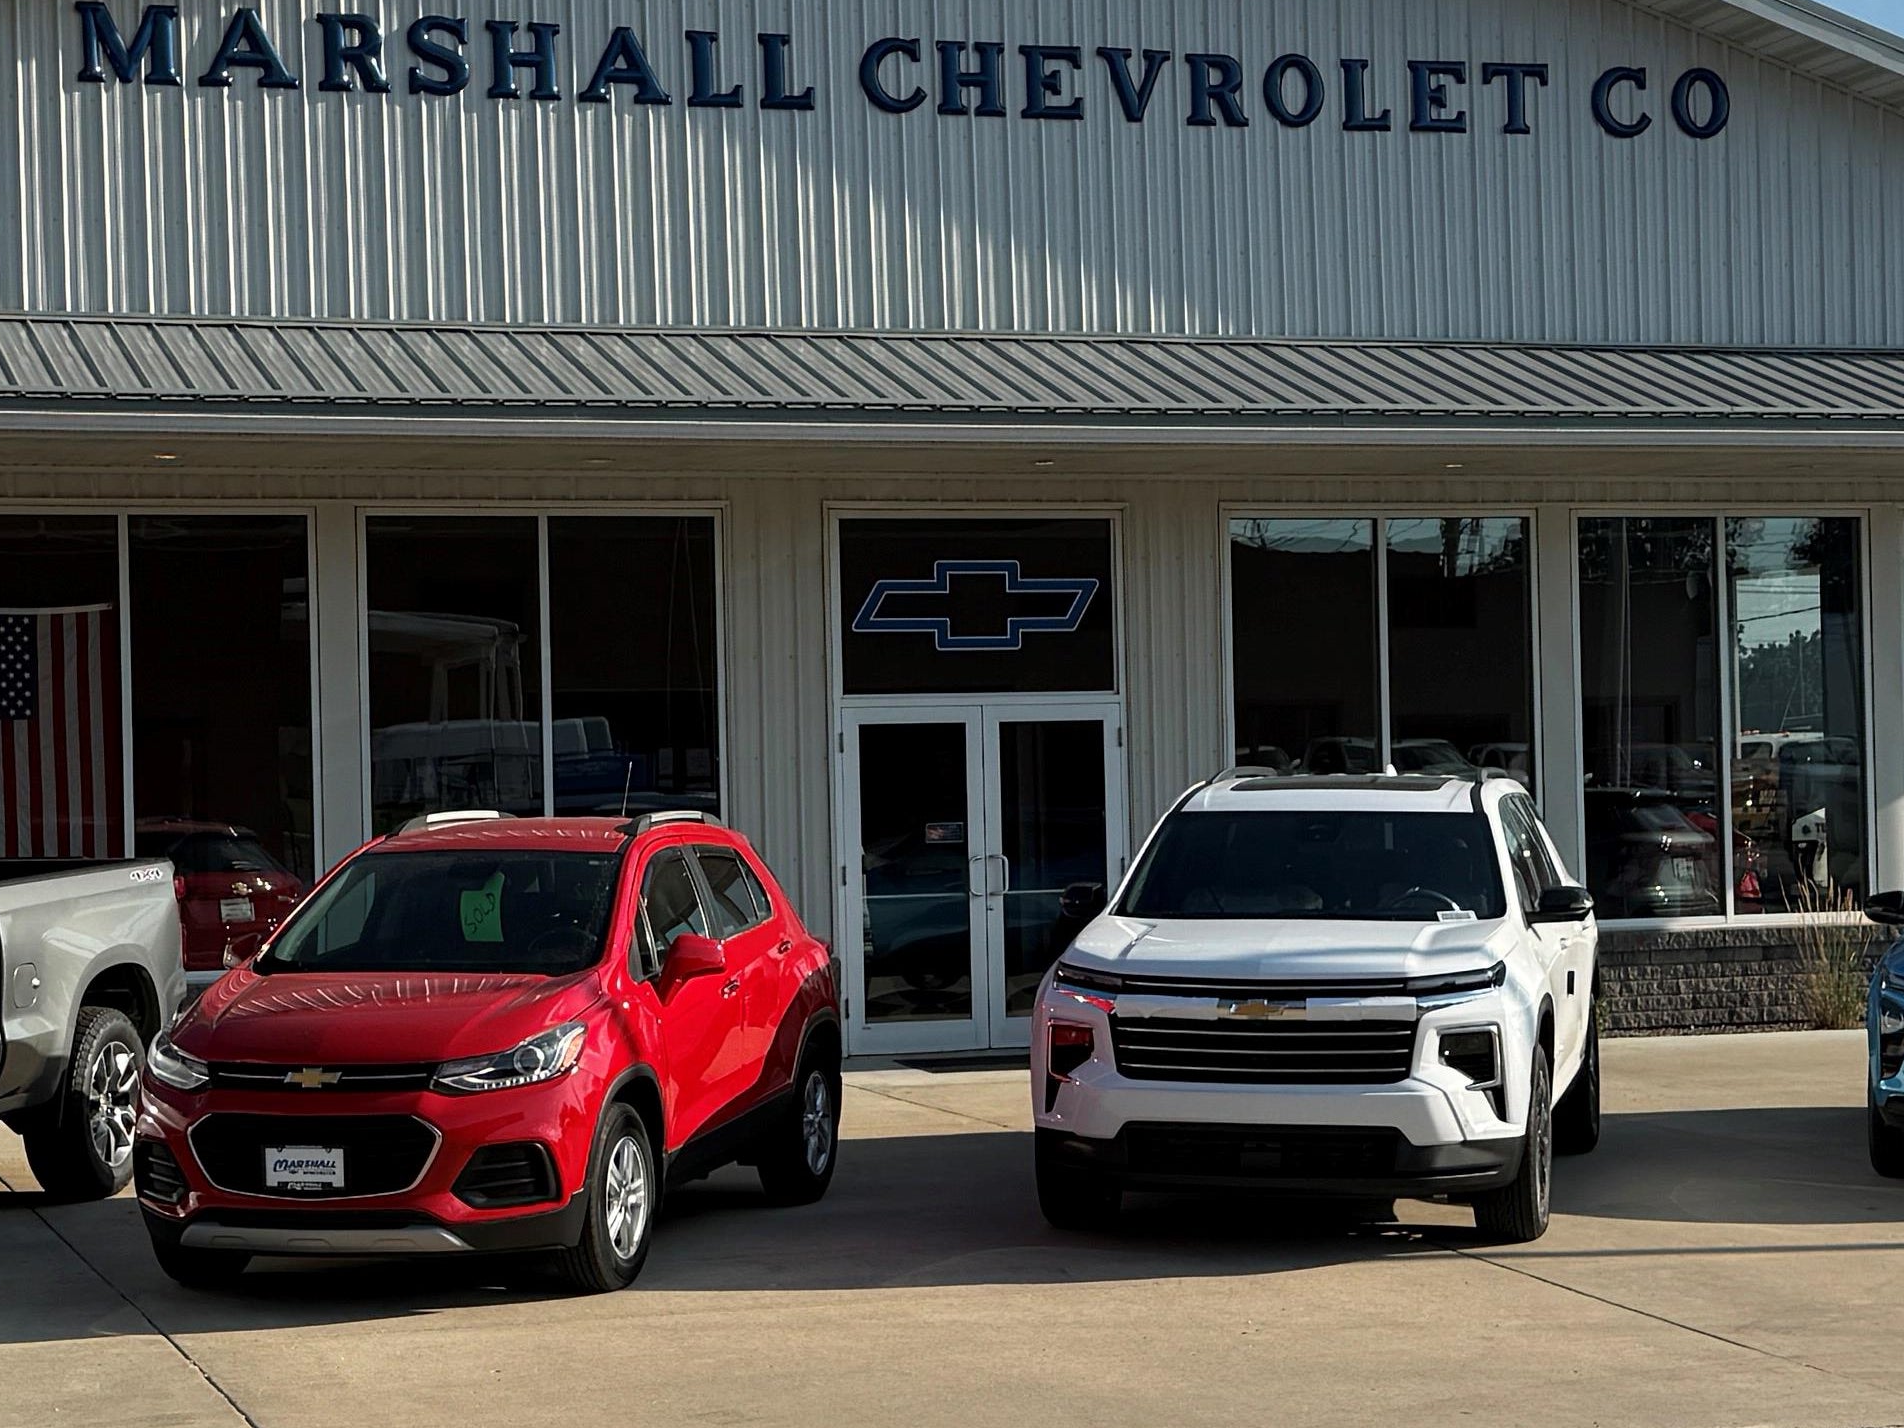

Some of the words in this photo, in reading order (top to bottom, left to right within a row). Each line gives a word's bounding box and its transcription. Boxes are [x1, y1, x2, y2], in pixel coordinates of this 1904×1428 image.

[74, 0, 816, 111] MARSHALL
[858, 36, 1550, 135] CHEVROLET
[1590, 65, 1731, 140] CO
[464, 892, 496, 934] SOLD
[273, 1158, 337, 1173] MARSHALL
